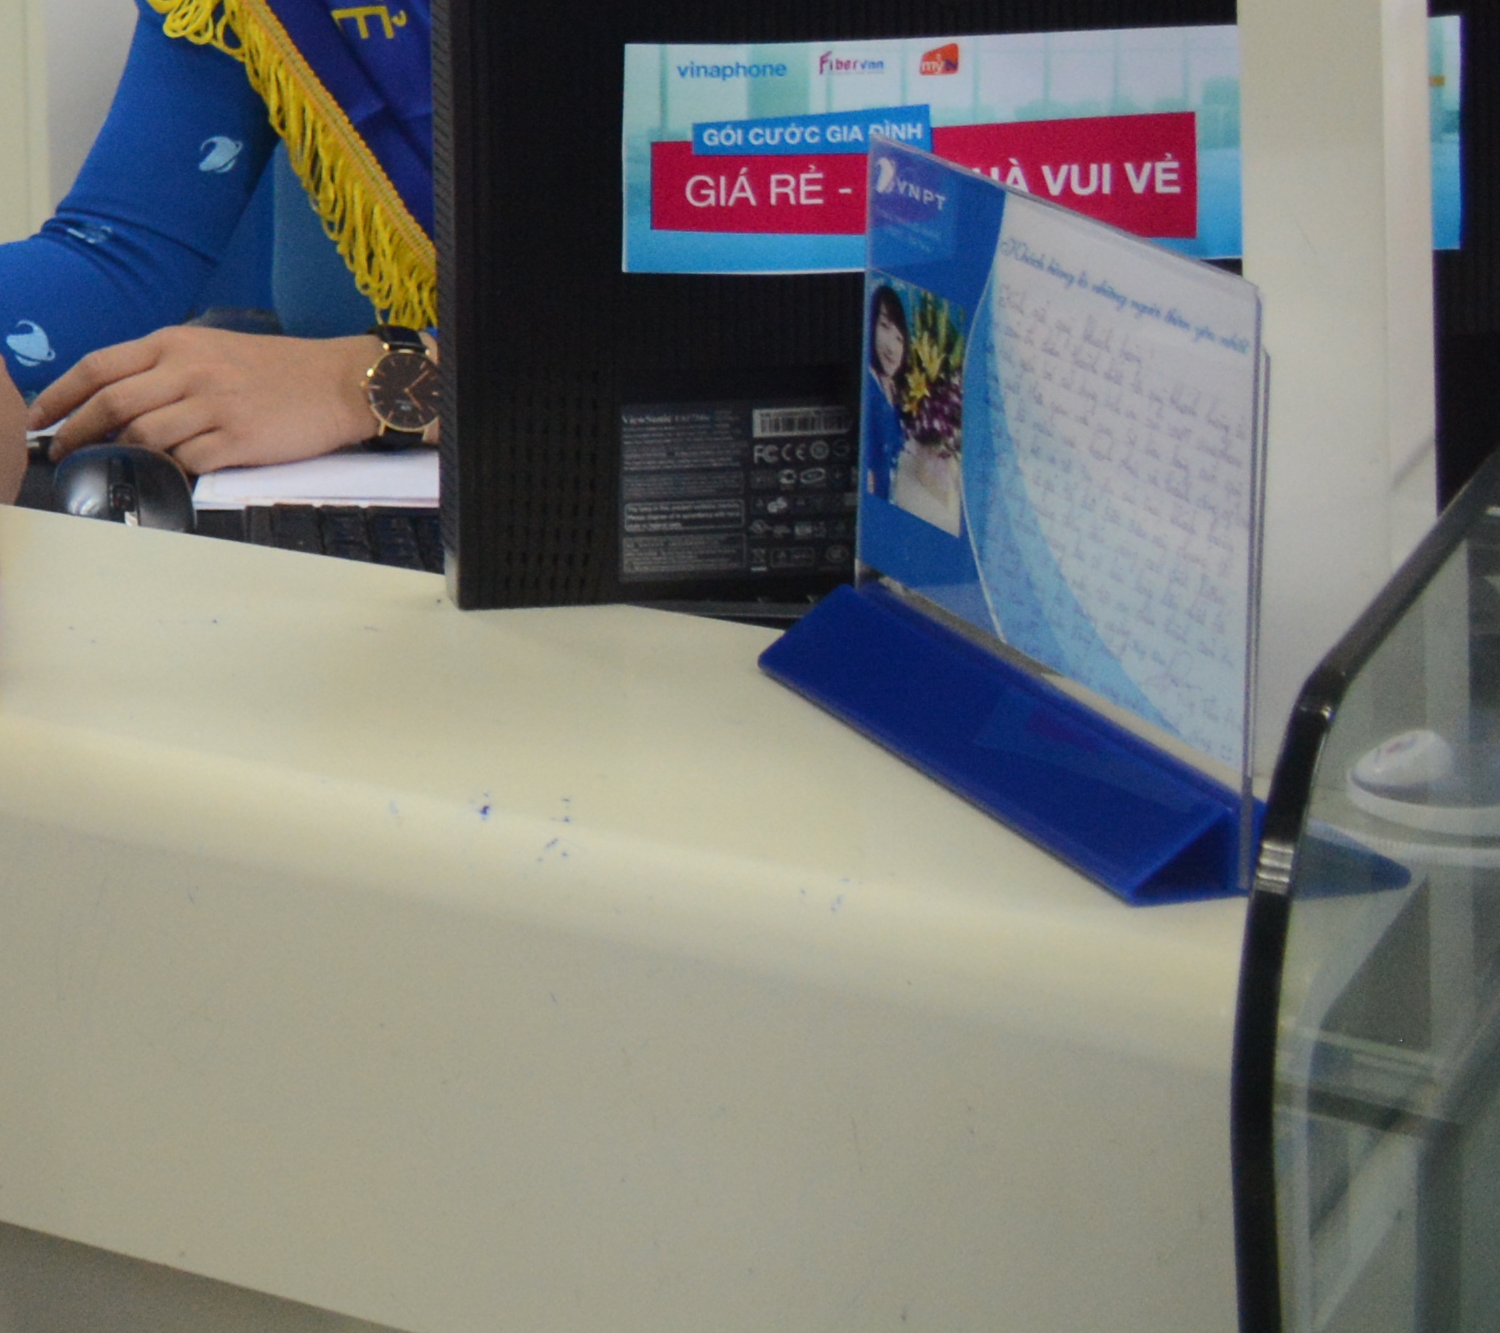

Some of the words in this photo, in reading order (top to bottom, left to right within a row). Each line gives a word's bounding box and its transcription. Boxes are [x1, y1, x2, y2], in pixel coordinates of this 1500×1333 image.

[676, 61, 788, 81] vinaphone
[703, 125, 743, 146] GÓI
[748, 125, 819, 145] CƯỚC
[825, 125, 864, 143] GIA
[684, 167, 757, 207] GIÁ
[770, 164, 825, 206] RẺ
[1041, 162, 1112, 196] VUI
[1124, 152, 1182, 195] VẺ
[896, 177, 947, 211] VNPT
